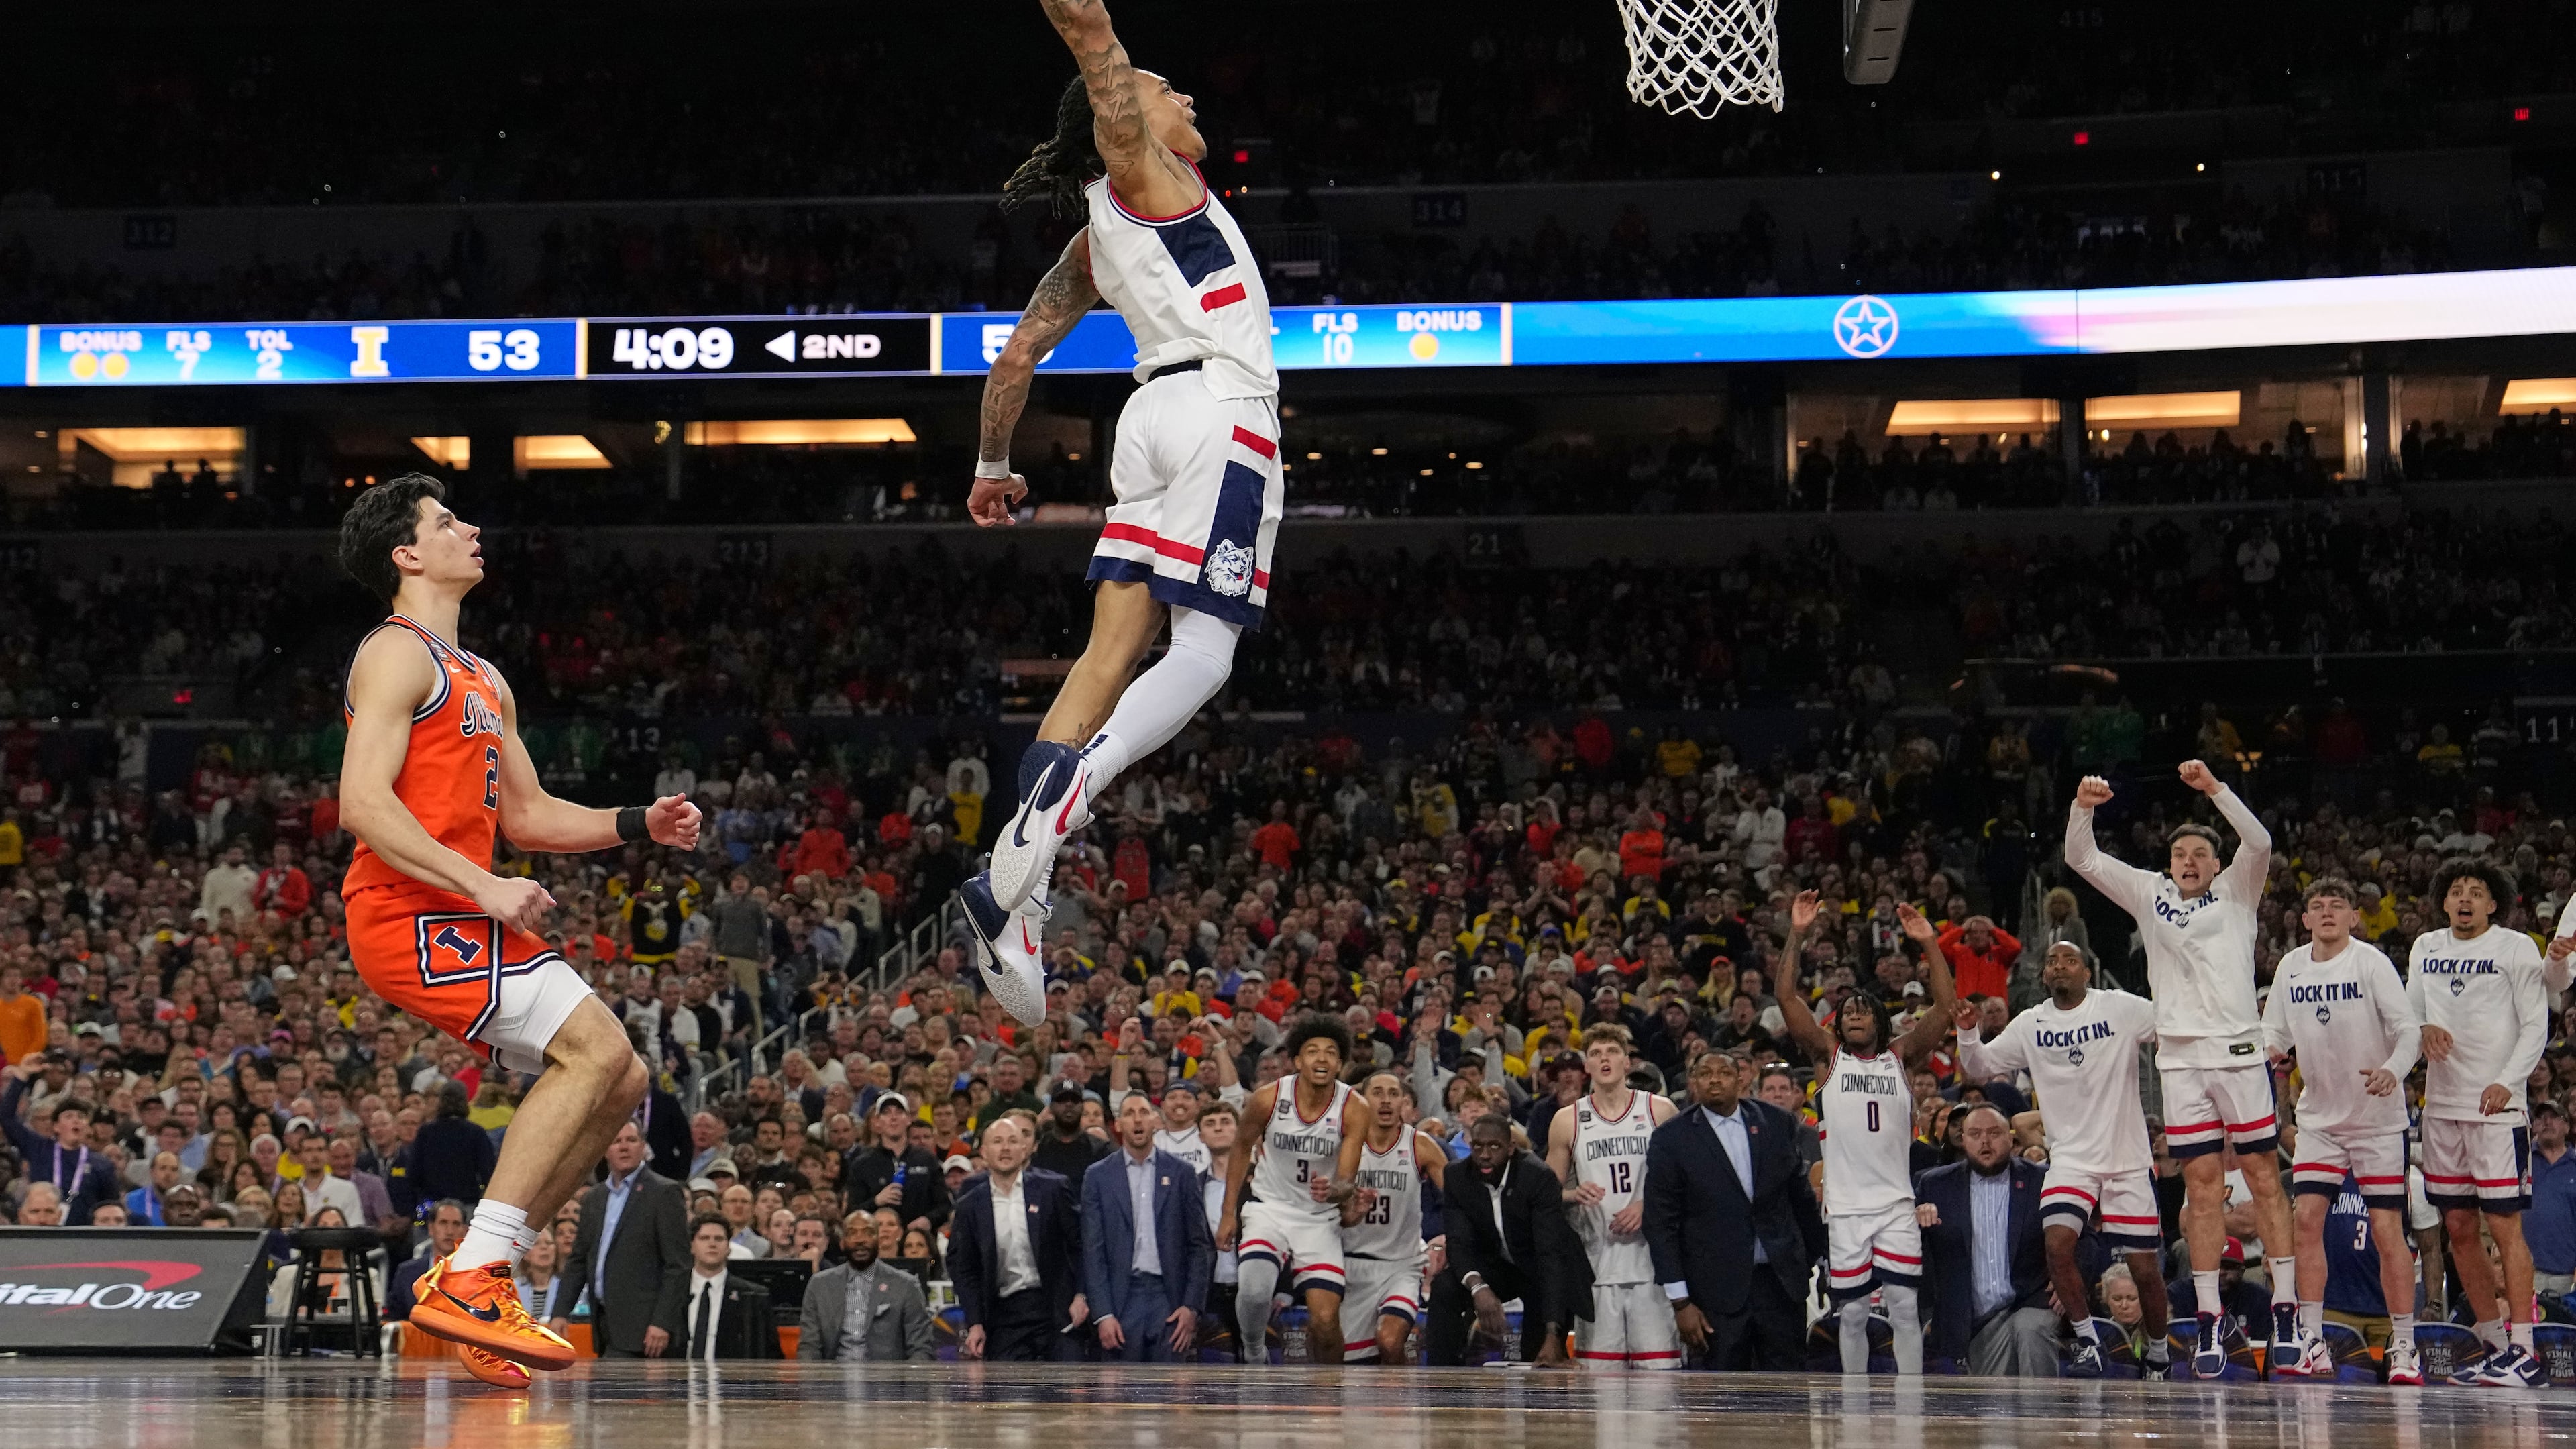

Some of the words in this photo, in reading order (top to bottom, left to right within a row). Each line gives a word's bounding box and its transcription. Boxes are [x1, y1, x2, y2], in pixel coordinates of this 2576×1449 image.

[1313, 312, 1358, 333] FLS
[1396, 310, 1482, 332] BONUS
[60, 330, 142, 352] BONUS
[166, 330, 211, 352] FLS
[245, 329, 293, 350] TOL
[350, 326, 390, 377] I
[468, 329, 540, 371] 53
[612, 327, 735, 370] 4:09
[802, 334, 881, 359] 2ND
[981, 323, 1054, 364] 5
[1323, 333, 1354, 364] 10
[174, 350, 200, 380] 7
[256, 348, 283, 380] 2
[2525, 715, 2576, 743] 11
[483, 745, 499, 810] 2
[433, 925, 483, 965] I
[2423, 957, 2459, 974] LOCK
[2459, 959, 2476, 974] IT
[2476, 959, 2499, 975] IN.
[2290, 984, 2323, 1003] LOCK
[2326, 984, 2339, 1002] IT
[2341, 981, 2363, 1000] IN.
[2037, 1030, 2075, 1047] LOCK
[2077, 1025, 2090, 1044] IT
[2092, 1020, 2116, 1040] IN.
[1841, 1073, 1898, 1096] CONNECTICUT
[1867, 1101, 1880, 1132] 0
[1274, 1132, 1335, 1157] CONNECTICUT
[1586, 1136, 1648, 1161] CONNECTICUT
[1296, 1159, 1309, 1183] 3
[1355, 1169, 1407, 1192] ONNECTICUT
[1609, 1162, 1632, 1194] 12
[2353, 1220, 2368, 1251] 3
[2426, 1347, 2453, 1358] FINAL
[2428, 1365, 2454, 1375] FOUR
[2550, 1367, 2575, 1378] FOUR
